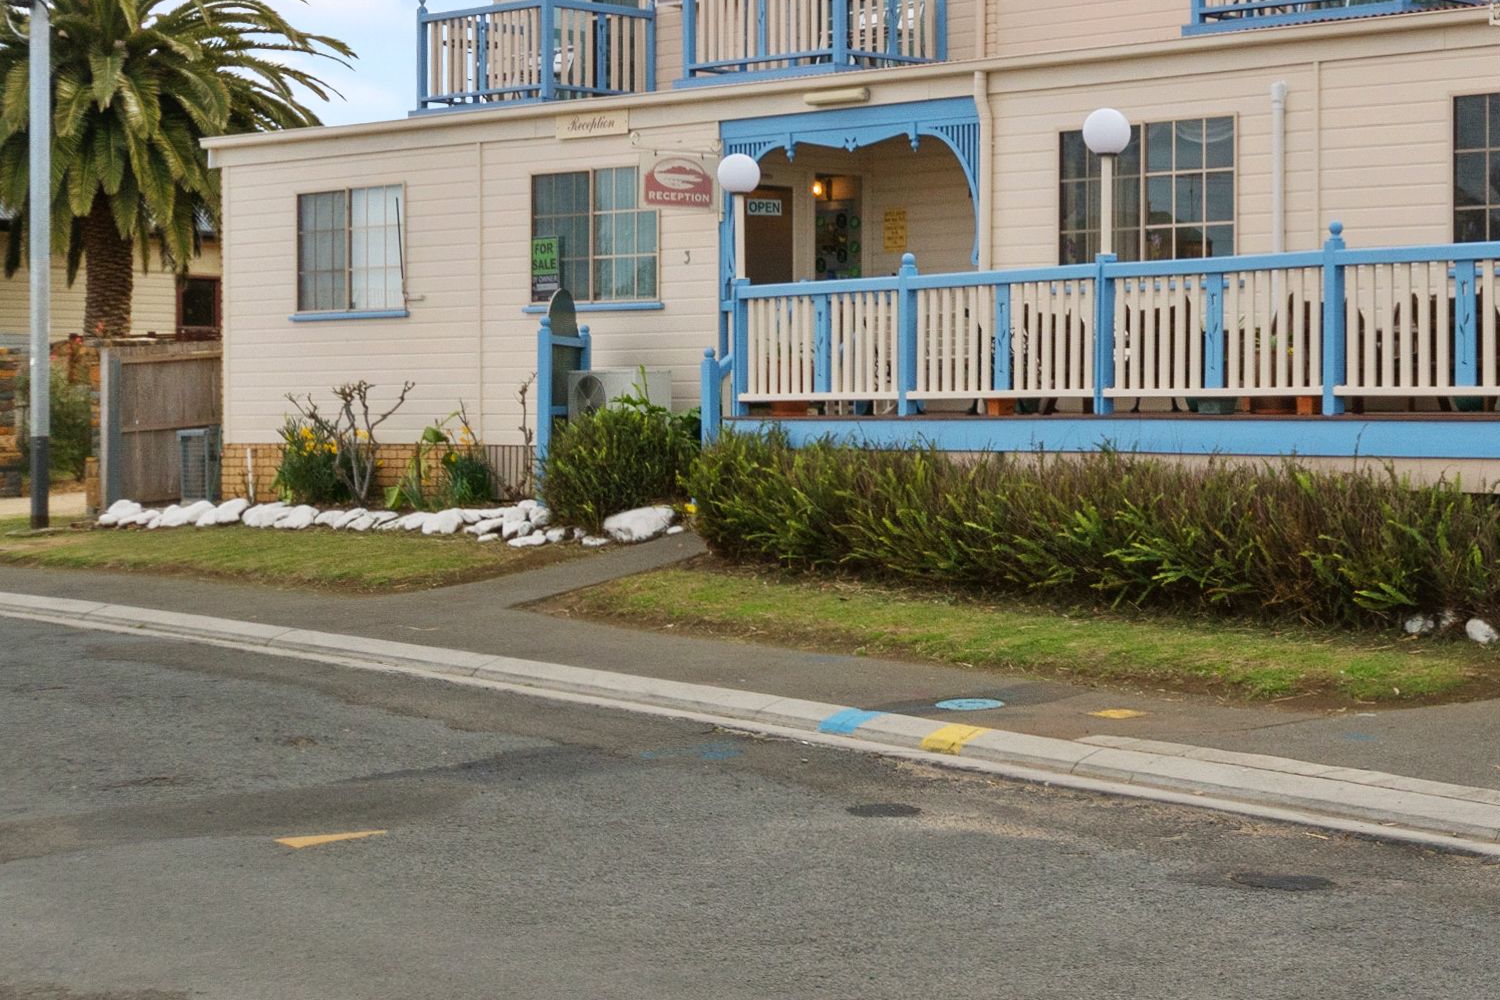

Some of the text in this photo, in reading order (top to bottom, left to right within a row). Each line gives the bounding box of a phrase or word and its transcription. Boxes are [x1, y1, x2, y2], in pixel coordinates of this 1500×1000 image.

[567, 113, 615, 133] Reception
[648, 190, 710, 203] RECEPTION
[749, 201, 780, 213] OPEN
[534, 242, 554, 255] FOR
[532, 257, 557, 270] SALE
